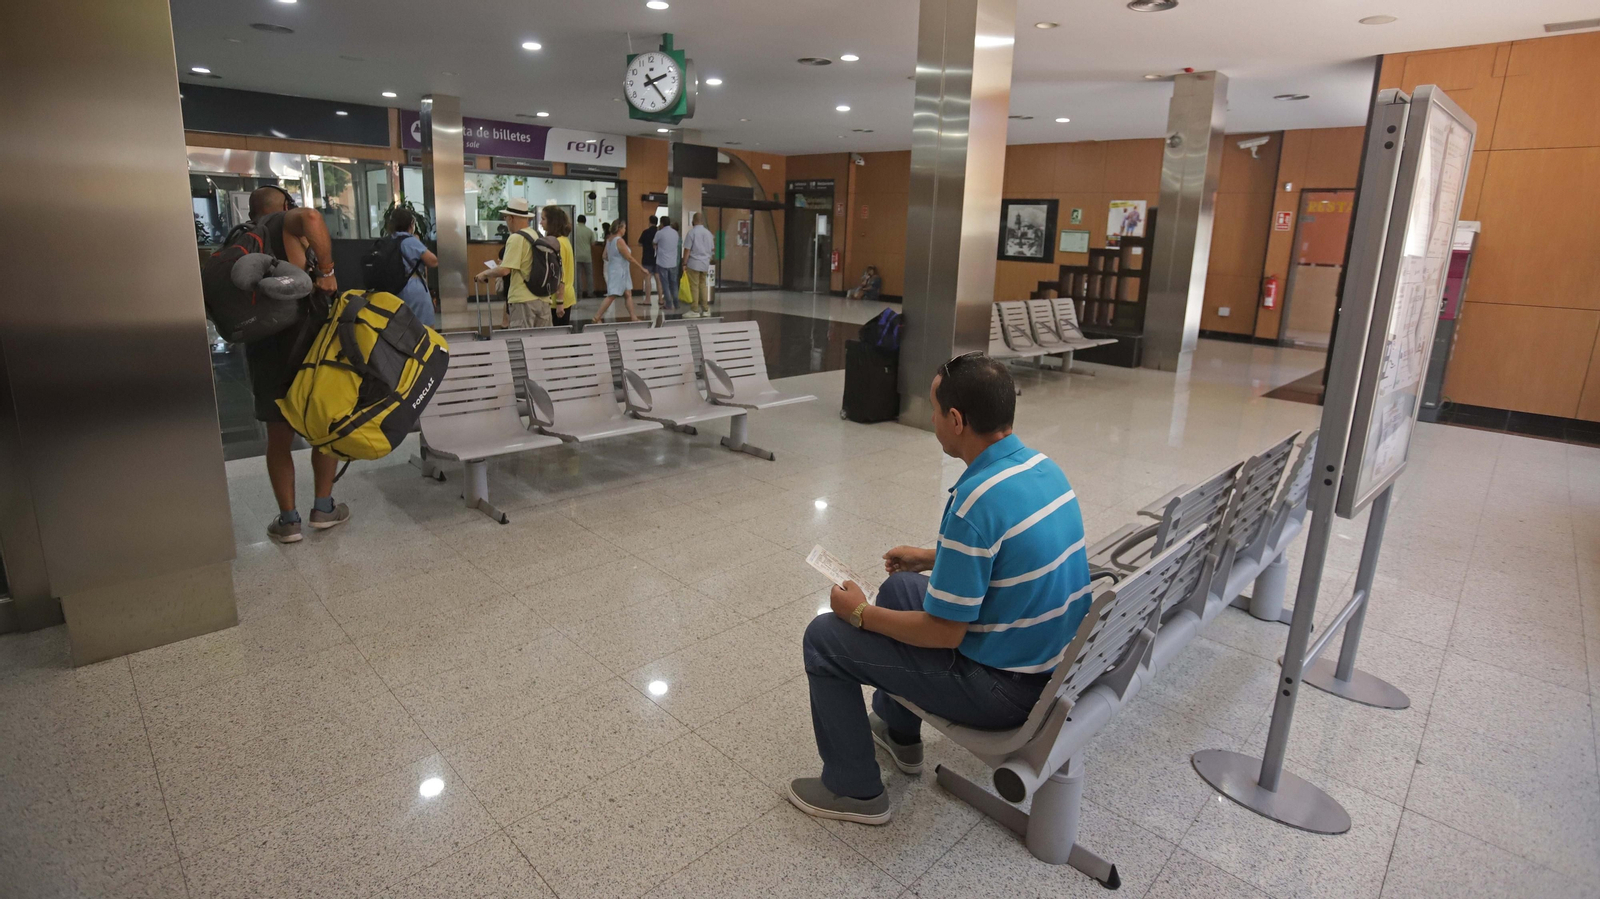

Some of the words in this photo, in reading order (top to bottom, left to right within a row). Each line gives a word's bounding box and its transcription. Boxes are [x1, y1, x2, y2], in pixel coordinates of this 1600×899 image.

[671, 76, 676, 84] 3
[640, 98, 645, 107] 7
[462, 126, 473, 137] ta
[476, 126, 490, 139] de
[493, 127, 531, 143] billetes
[567, 138, 615, 159] renfe
[1307, 201, 1353, 213] RESTA
[412, 377, 435, 409] FORCLAZ
